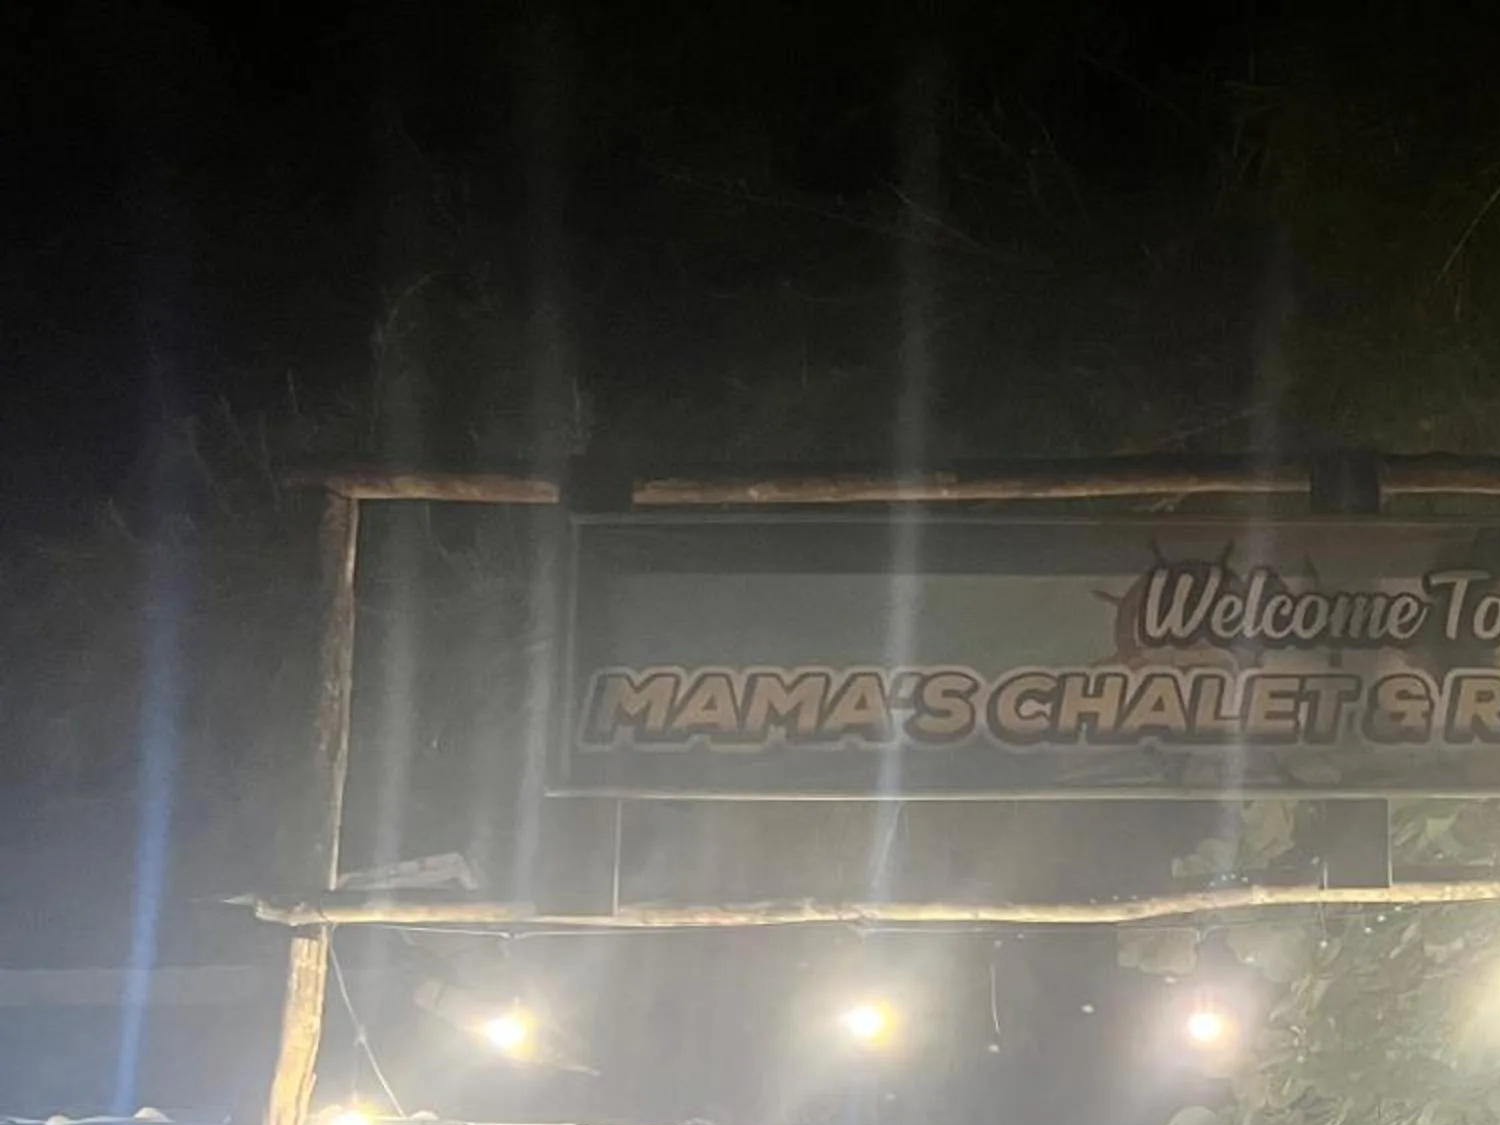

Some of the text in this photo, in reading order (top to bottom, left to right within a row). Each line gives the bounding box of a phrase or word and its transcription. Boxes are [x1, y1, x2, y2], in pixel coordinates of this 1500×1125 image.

[1143, 567, 1427, 645] Welcome
[588, 669, 982, 744] MAMA'S
[987, 671, 1358, 744] CHALET
[1364, 672, 1434, 744] &
